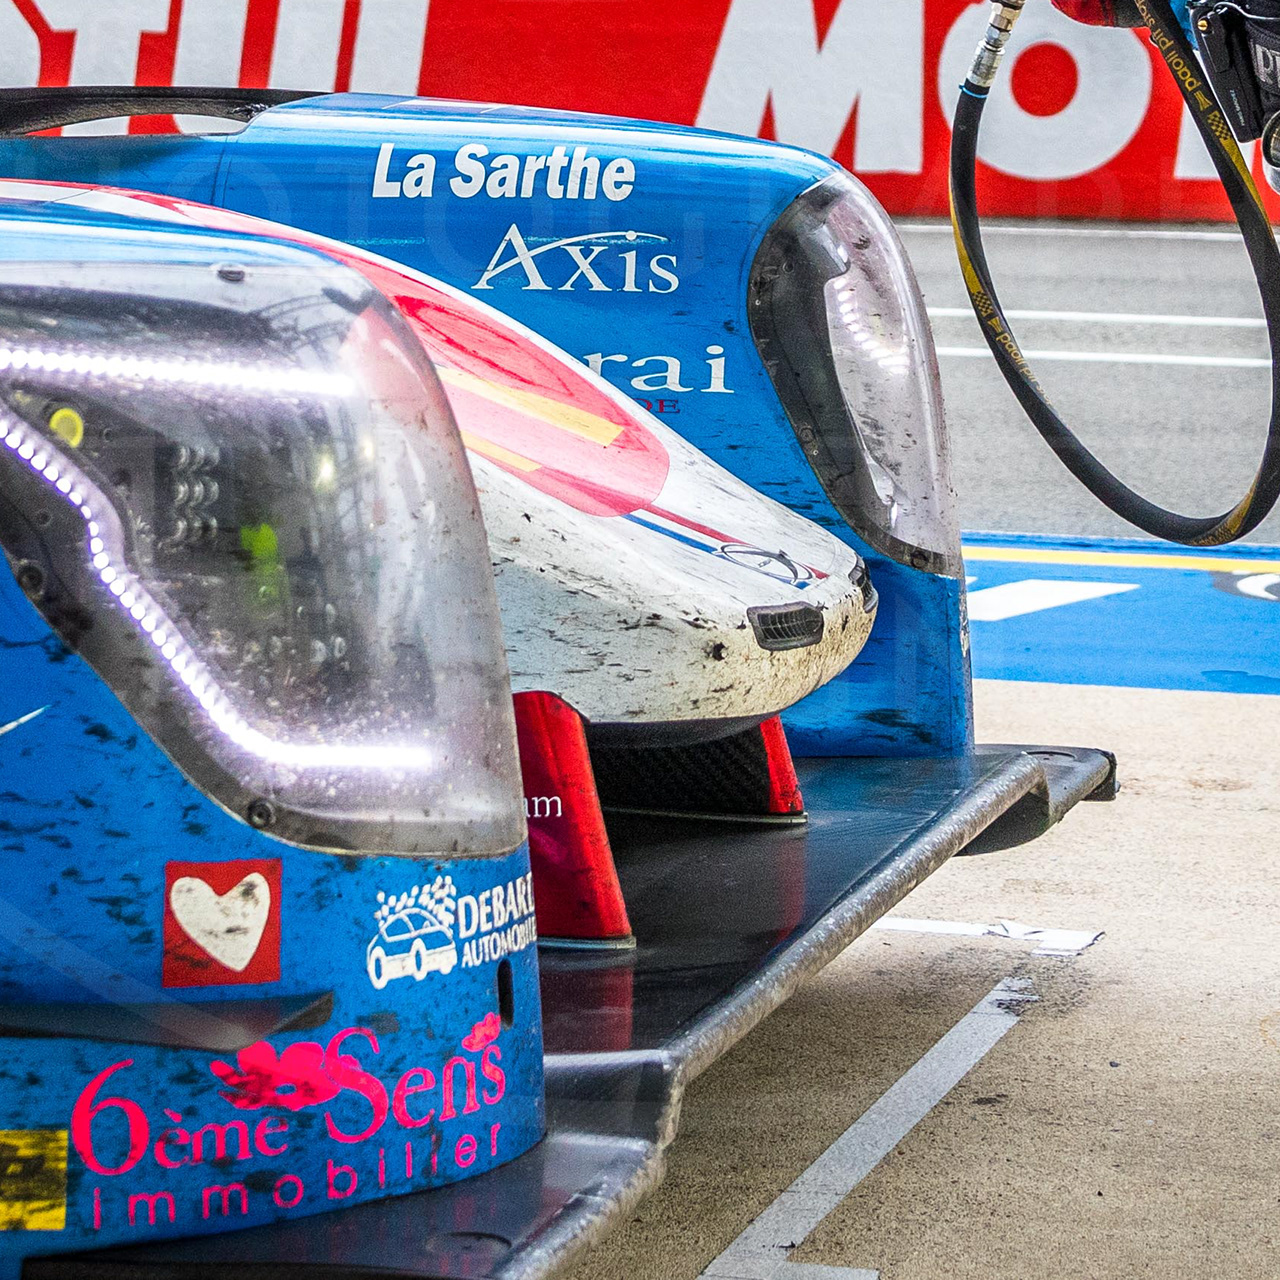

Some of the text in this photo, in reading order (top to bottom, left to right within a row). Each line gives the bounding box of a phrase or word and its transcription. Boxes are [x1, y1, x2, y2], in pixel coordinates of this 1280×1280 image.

[1152, 26, 1178, 52] pit
[1167, 46, 1200, 92] paoli
[372, 142, 636, 201] La Sarthe
[470, 222, 680, 294] Axis
[583, 344, 735, 394] rai
[995, 332, 1026, 367] paoli
[71, 1025, 507, 1176] 6ème Sens
